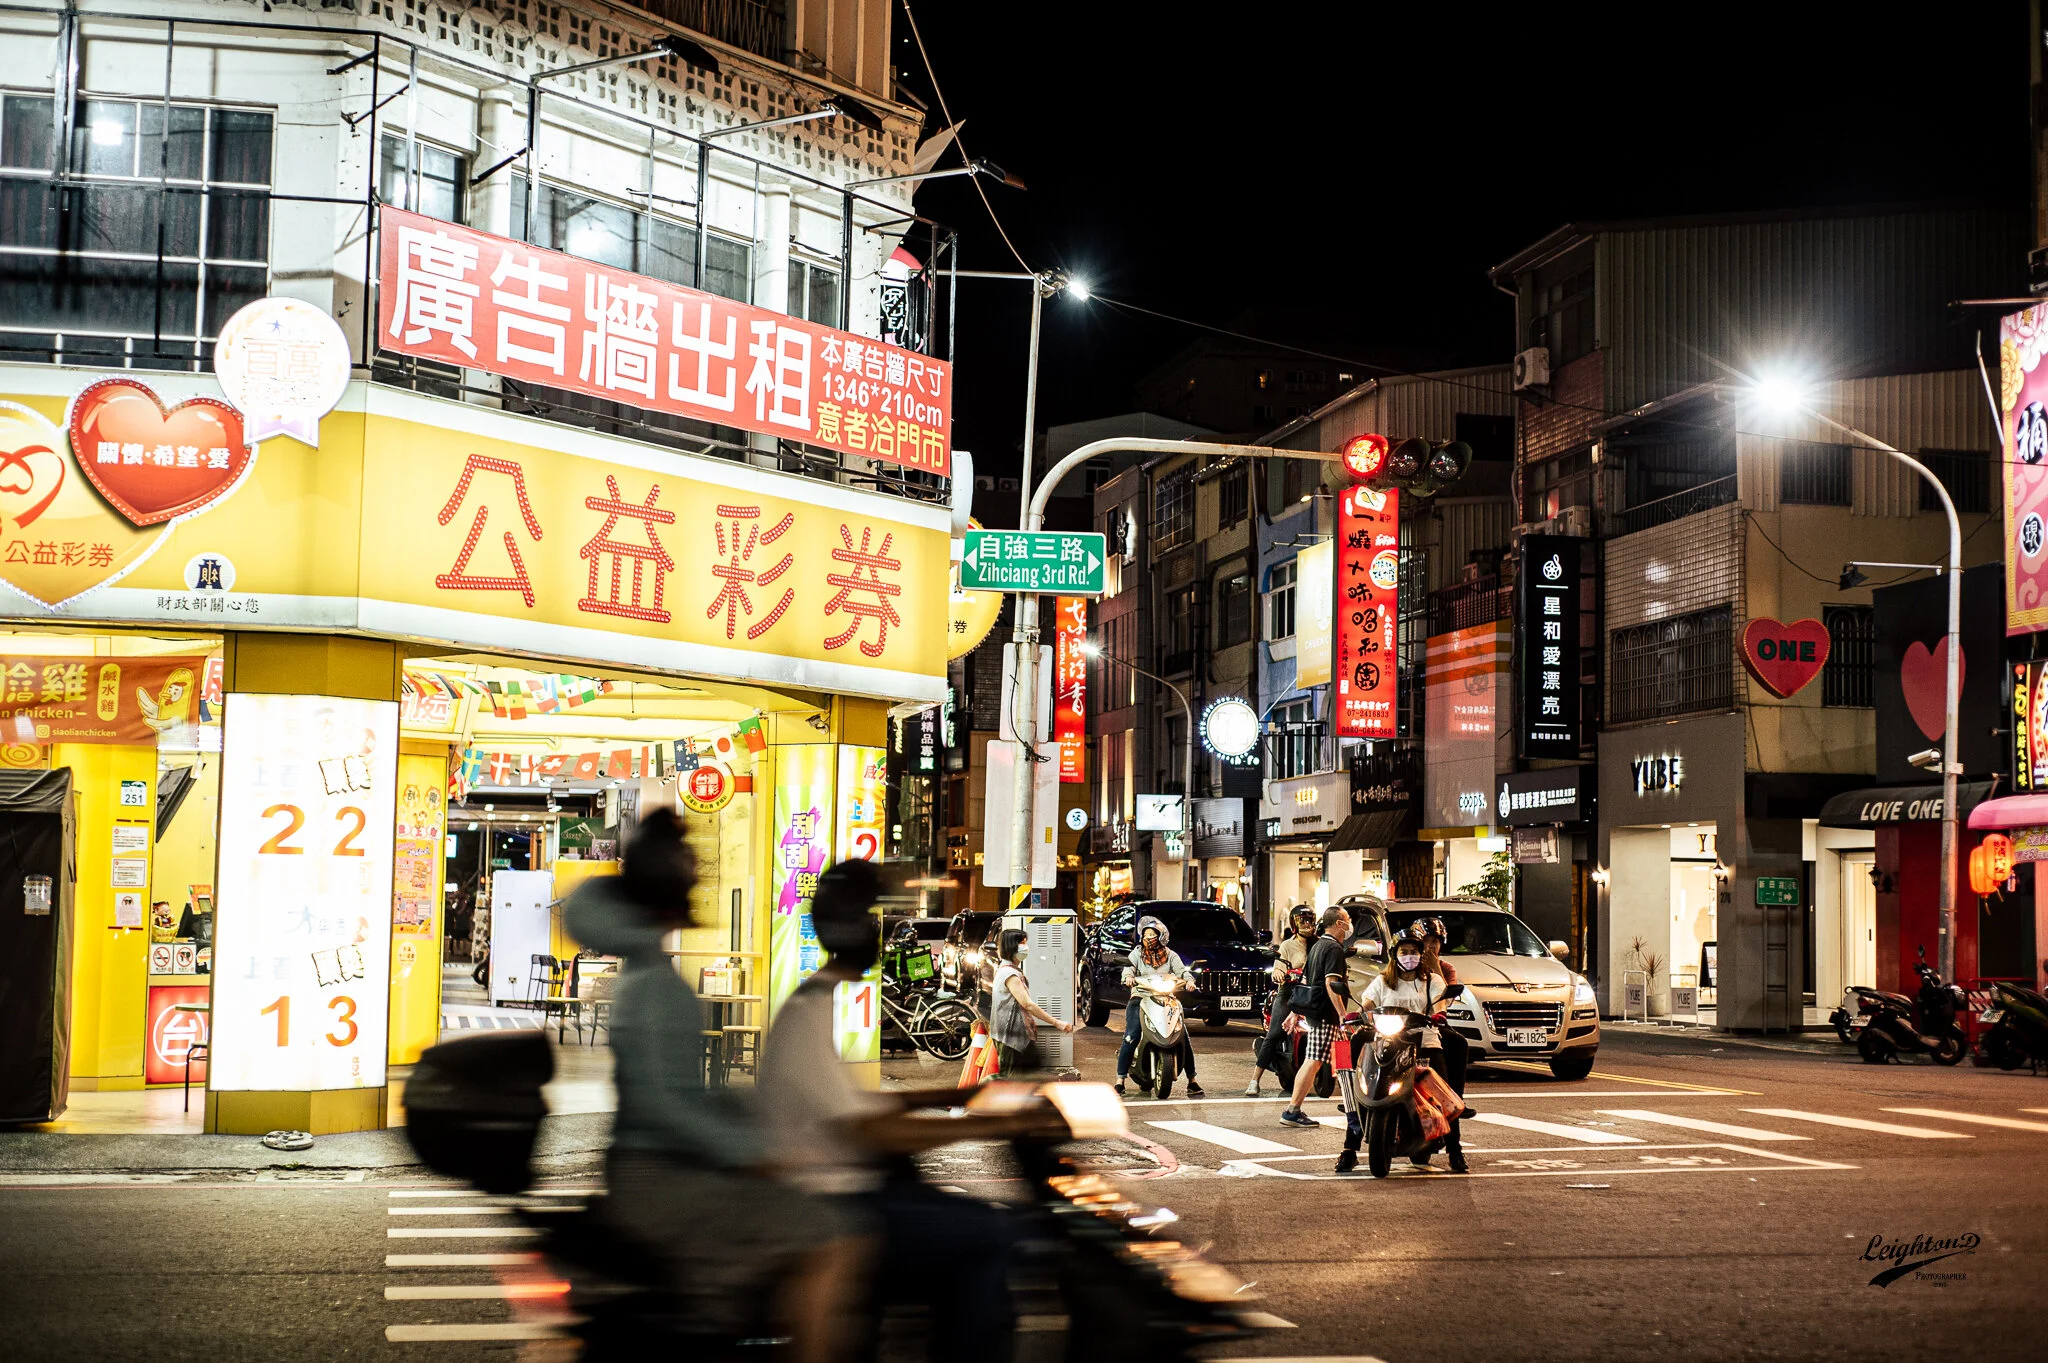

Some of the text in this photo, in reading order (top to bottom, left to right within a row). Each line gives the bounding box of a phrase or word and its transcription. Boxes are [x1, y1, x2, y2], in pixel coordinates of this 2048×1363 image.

[390, 225, 813, 433] 廣告牆出租
[819, 334, 945, 398] 本廣告牆尺寸
[816, 400, 944, 469] 意者洽門市
[5, 539, 115, 568] 公益彩券
[435, 452, 902, 659] 公益彩券
[979, 535, 1085, 562] 自強三路
[979, 564, 1090, 588] Zihciang 3rd Rd.
[156, 596, 261, 614] 財政部關心您
[947, 620, 968, 633] 券
[1543, 597, 1562, 716] 星和愛漂亮
[1757, 639, 1816, 663] ONE
[1347, 709, 1390, 719] 07-2416833
[1341, 726, 1392, 735] 0980-068-068
[695, 773, 719, 786] 台灣
[1629, 756, 1681, 795] YUBE
[124, 793, 143, 804] 251
[1861, 799, 1943, 821] LOVE ONE
[258, 804, 366, 857] 2 2
[785, 812, 816, 899] 刮刮樂
[856, 832, 878, 862] 2
[799, 914, 819, 985] 專賣
[261, 995, 359, 1047] 1 3
[855, 986, 871, 1028] 1
